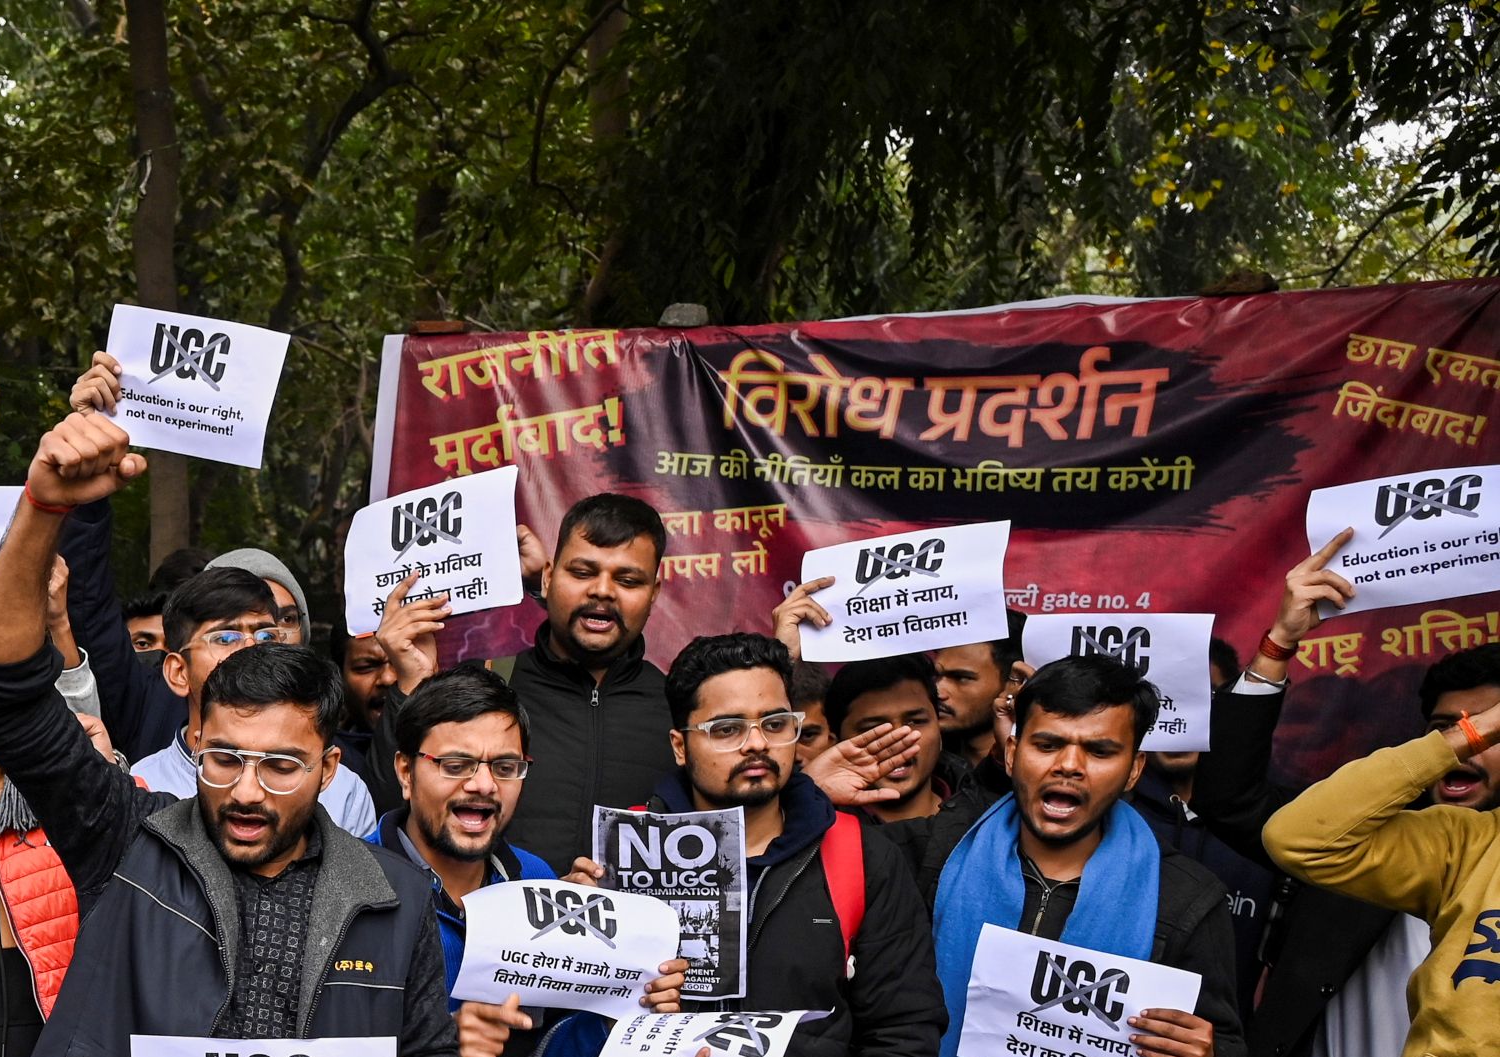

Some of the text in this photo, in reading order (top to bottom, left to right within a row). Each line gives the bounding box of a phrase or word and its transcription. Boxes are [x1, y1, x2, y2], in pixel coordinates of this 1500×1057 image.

[150, 323, 231, 383] UGC
[1346, 333, 1417, 369] छात्र
[120, 388, 244, 421] Education is our right,
[718, 346, 1169, 448] विरोध प्रदर्शन
[1332, 381, 1487, 445] जिंदाबाद!
[126, 408, 233, 436] not an experiment!
[655, 449, 1195, 492] आज की कल का भविष्य तय करेंगी
[1374, 474, 1482, 526] UGC
[391, 491, 462, 551] UGC
[713, 504, 787, 538] कानून
[434, 552, 482, 574] भविष्य
[731, 541, 767, 576] लो
[855, 538, 945, 585] UGC
[1342, 537, 1470, 568] Education is our
[455, 577, 488, 600] नहीं!
[1354, 568, 1406, 585] not an
[845, 584, 959, 616] शिक्षा में न्याय,
[1041, 592, 1150, 611] gate no. 4
[843, 611, 968, 644] देश का विकास!
[1296, 633, 1362, 675] राष्ट्र
[1159, 718, 1187, 734] नहीं!
[618, 823, 717, 870] NO
[618, 869, 718, 888] TO UGC
[522, 886, 618, 940] UGC
[501, 949, 643, 982] UGC होश में आओ, छात्र
[683, 968, 715, 976] NMENT
[685, 976, 721, 984] AGAINST
[493, 969, 633, 999] विरोधी नियम वापस लो!
[1030, 950, 1130, 1023] UGC
[1016, 1011, 1064, 1039] शिक्षा
[1067, 1025, 1083, 1044] में
[1006, 1034, 1036, 1057] देश
